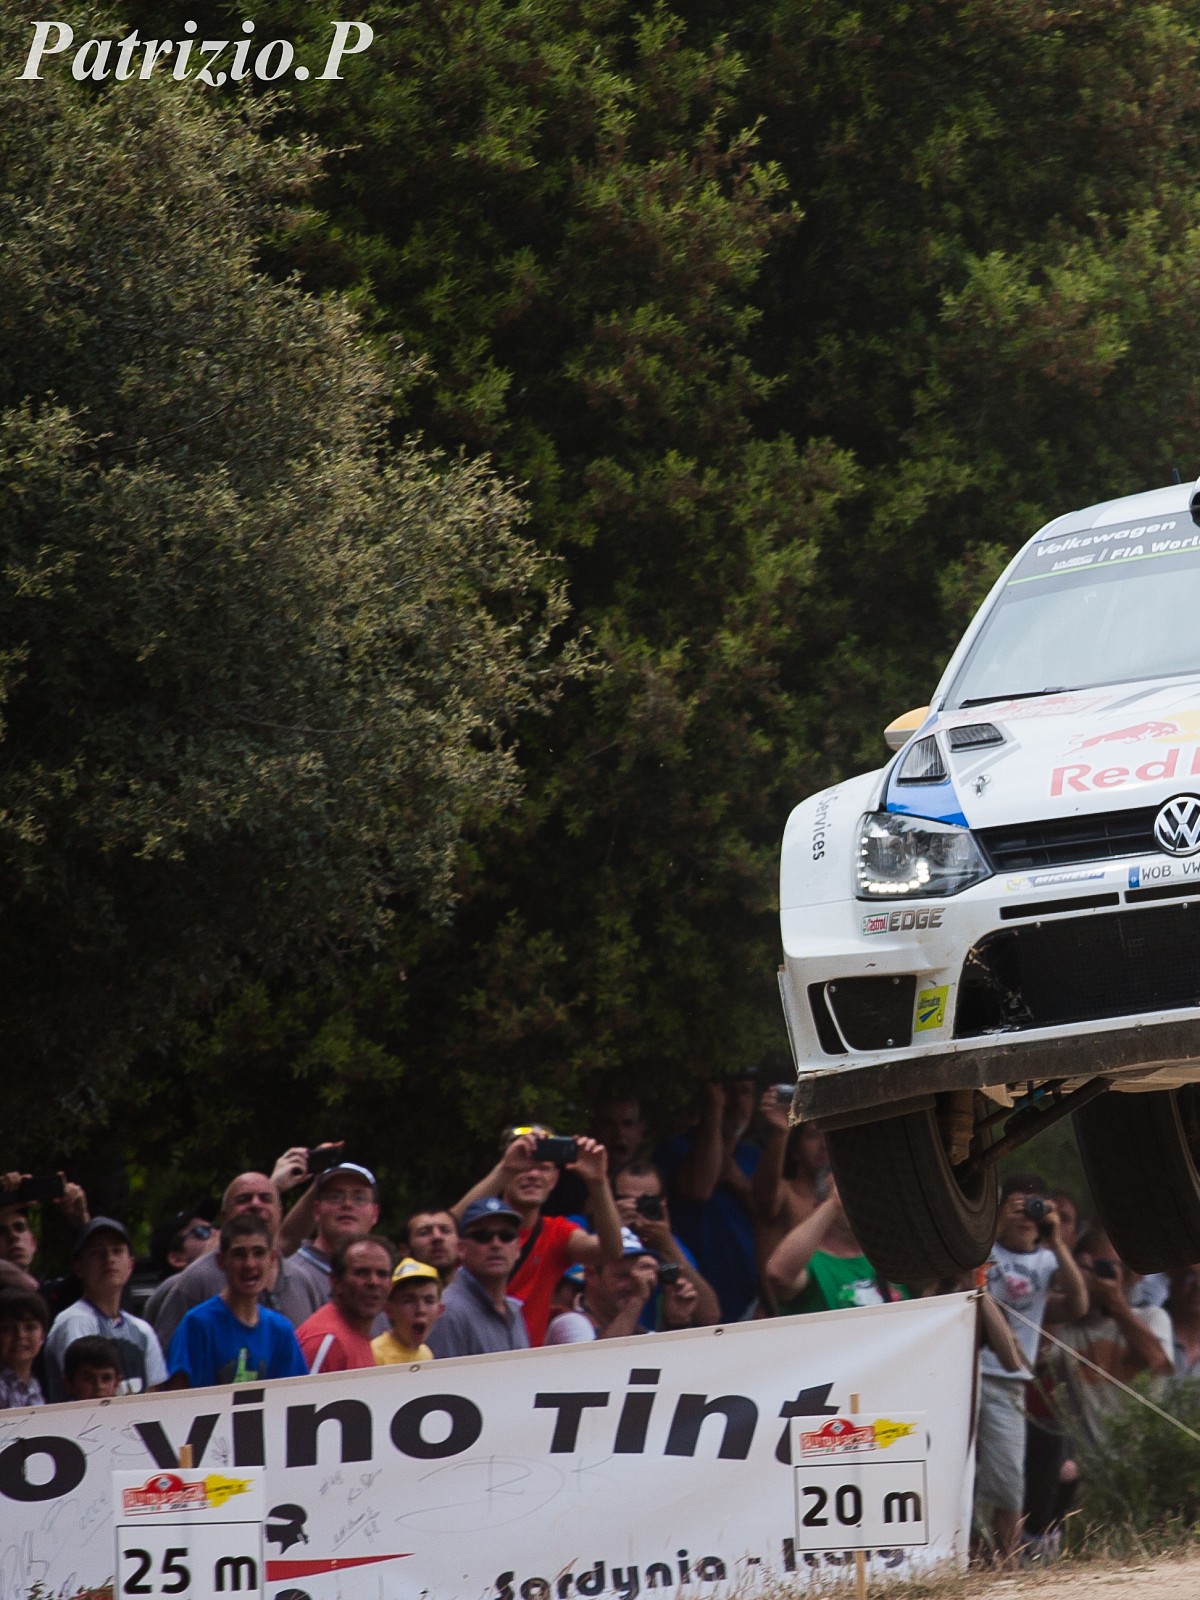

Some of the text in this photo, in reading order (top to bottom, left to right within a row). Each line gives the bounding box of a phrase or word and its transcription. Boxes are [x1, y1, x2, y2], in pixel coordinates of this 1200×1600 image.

[1036, 520, 1177, 558] Volkswagen
[1110, 545, 1144, 561] FIA
[1050, 747, 1180, 797] Red
[888, 908, 946, 932] EDGE
[133, 1388, 484, 1469] vino
[533, 1367, 930, 1466] Tint
[801, 1484, 923, 1527] 20 m
[123, 1547, 258, 1594] 25 m
